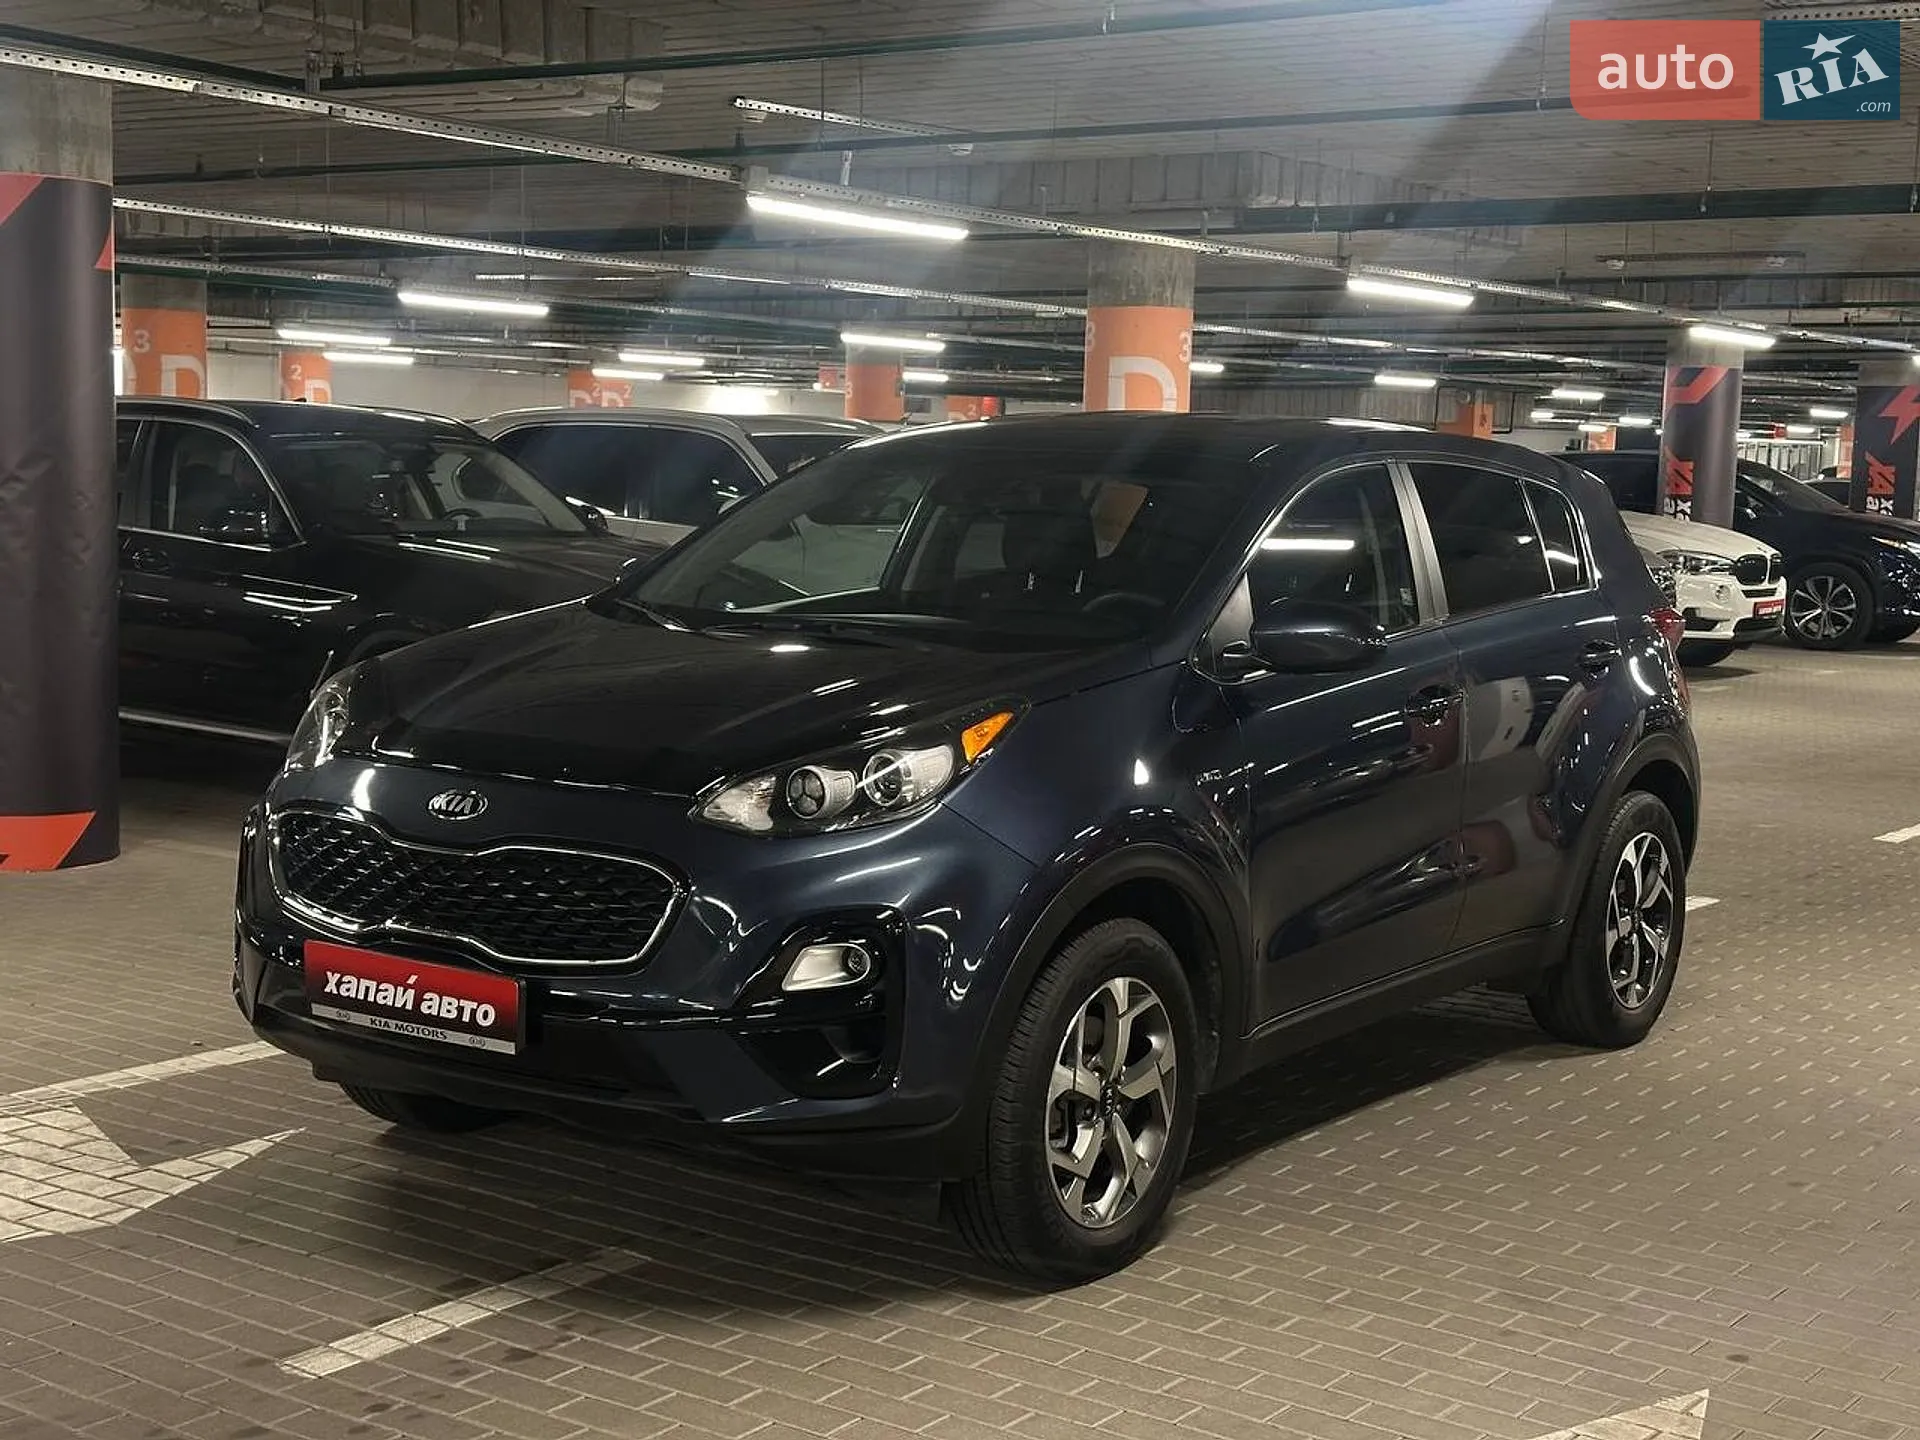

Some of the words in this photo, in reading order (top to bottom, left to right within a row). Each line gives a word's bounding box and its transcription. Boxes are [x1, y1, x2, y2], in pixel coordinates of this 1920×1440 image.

[133, 329, 150, 354] 3
[290, 364, 301, 380] 2
[419, 991, 496, 1027] авто
[369, 1017, 391, 1029] KIA
[394, 1022, 448, 1041] MOTORS
